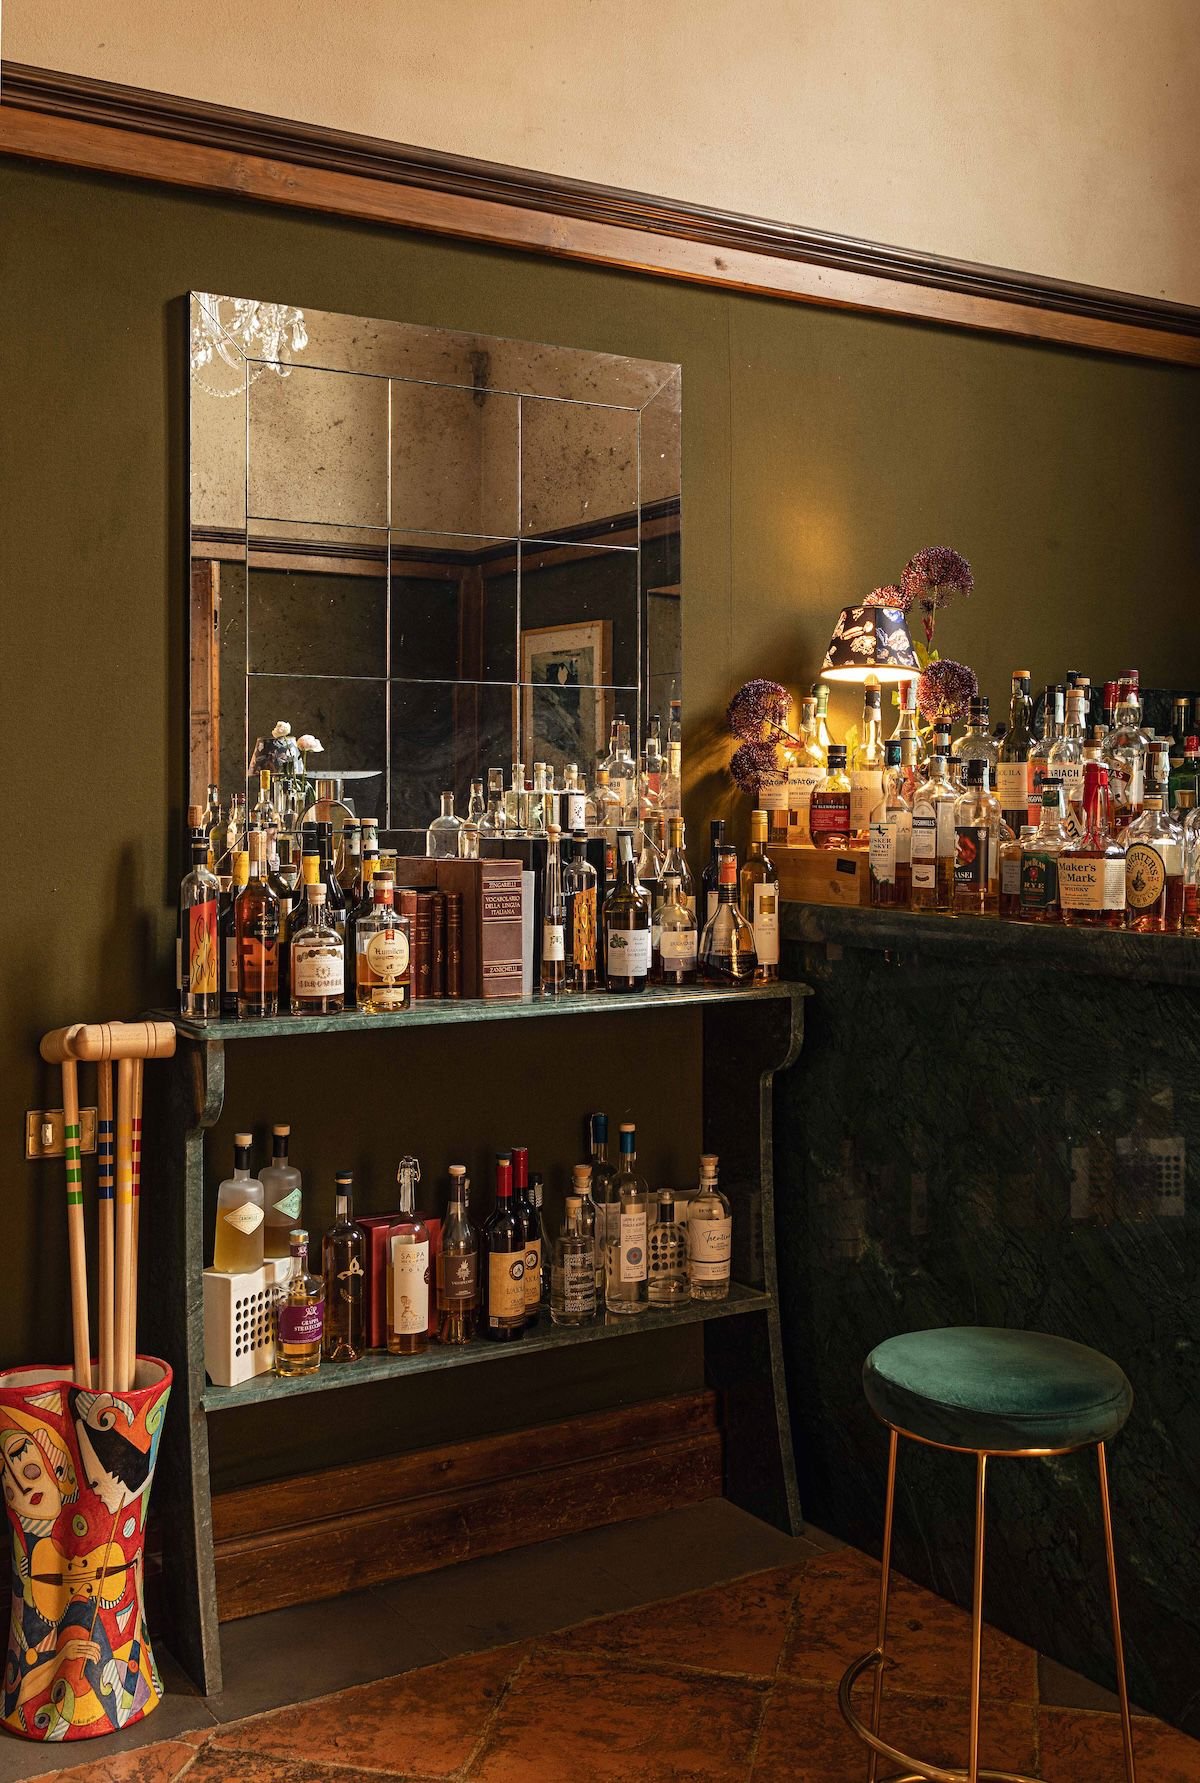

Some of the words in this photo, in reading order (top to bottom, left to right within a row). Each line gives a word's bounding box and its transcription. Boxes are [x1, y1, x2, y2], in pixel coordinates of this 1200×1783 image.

[1058, 862, 1097, 872] Maker's
[488, 881, 517, 889] ZINGARELLI
[485, 895, 521, 903] VOCABOLARIO
[489, 965, 518, 973] ZANICHELLI
